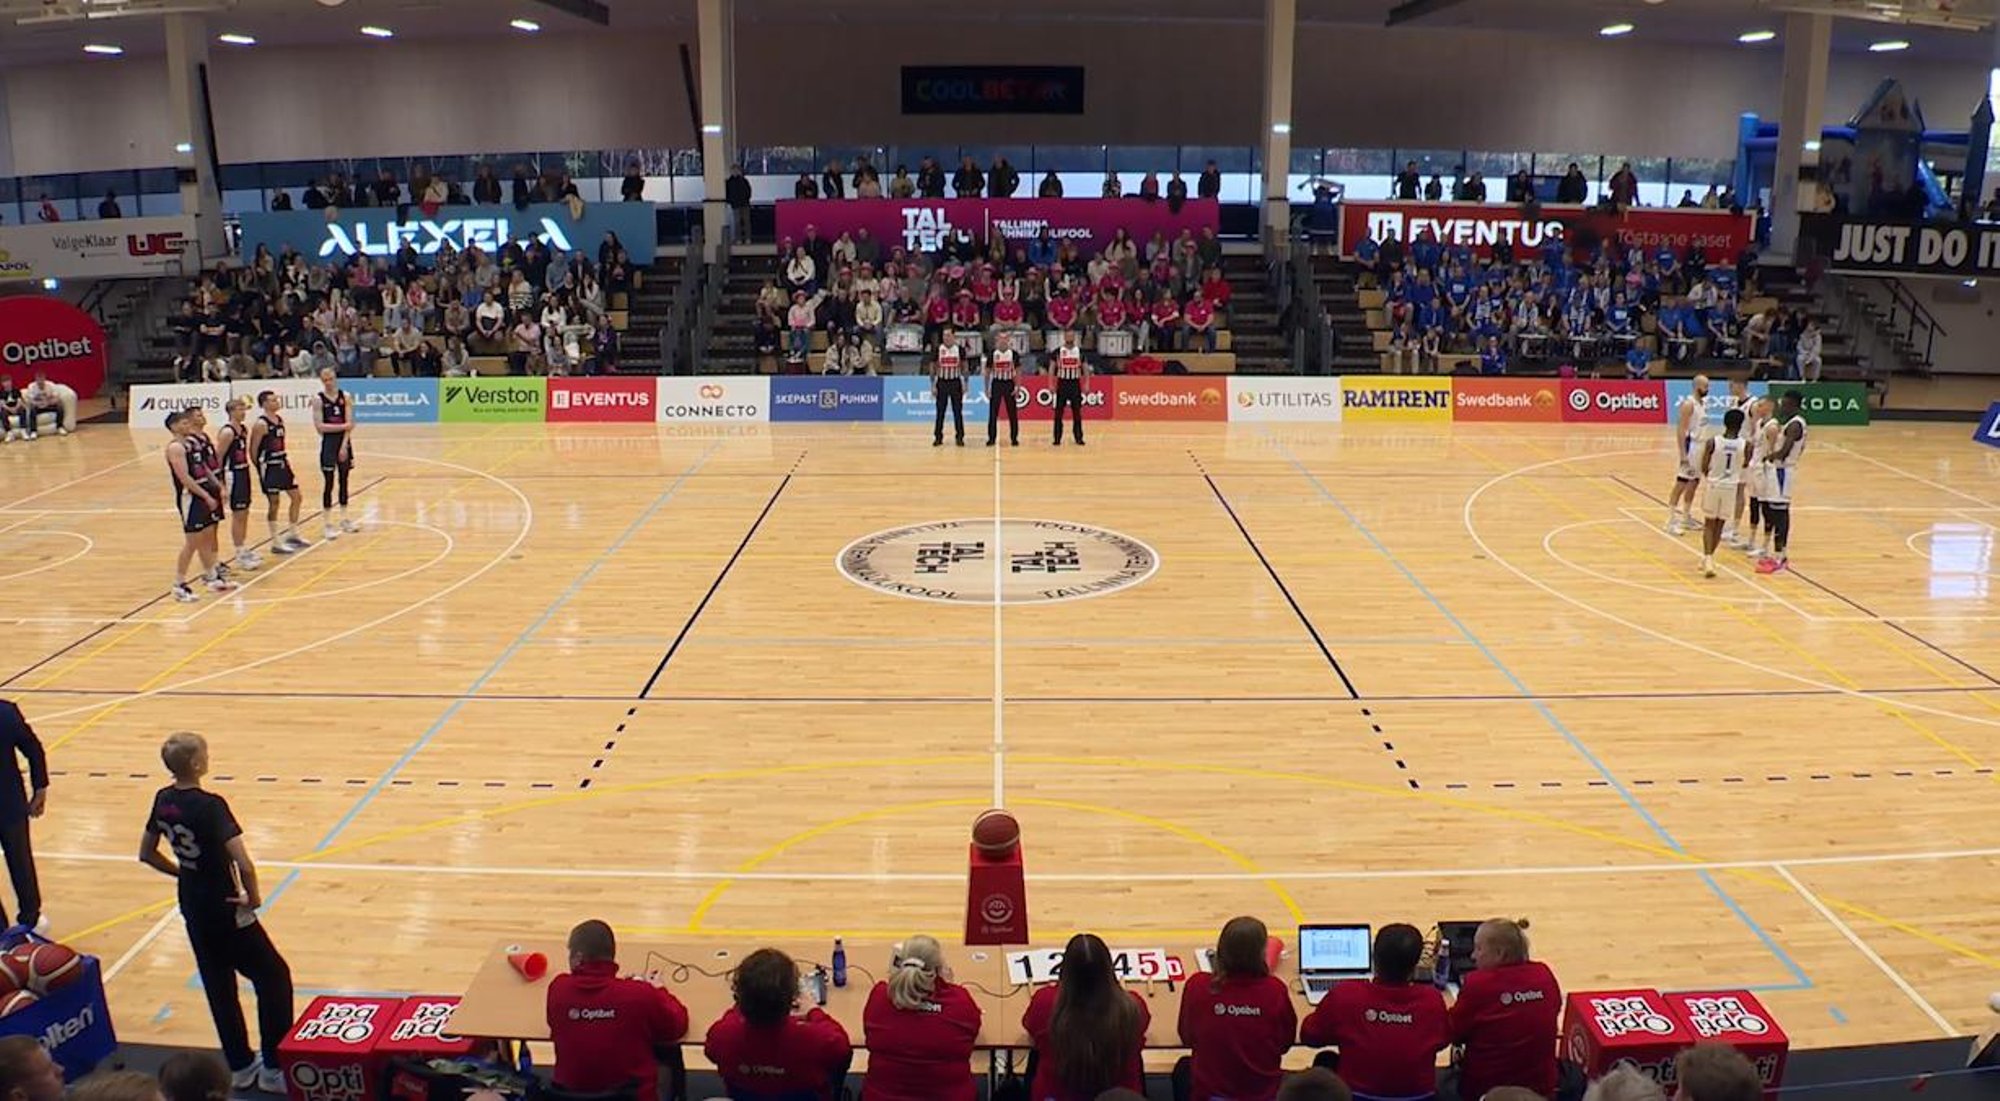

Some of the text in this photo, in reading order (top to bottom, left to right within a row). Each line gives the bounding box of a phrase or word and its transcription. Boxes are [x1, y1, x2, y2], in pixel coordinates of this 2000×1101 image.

[902, 207, 952, 230] TAL
[318, 217, 572, 257] ALEXELA
[902, 229, 970, 252] TEC
[1833, 224, 1911, 264] JUST
[1918, 228, 1968, 268] DO
[2, 336, 92, 365] Optibet
[350, 392, 430, 406] LEXELA
[465, 386, 539, 404] Verston
[572, 392, 650, 406] EVENTUS
[775, 394, 817, 405] SKEPAST
[892, 391, 988, 404] ALELA
[1037, 389, 1104, 409] Opbet
[1119, 391, 1197, 407] Swedbank
[1259, 392, 1331, 407] UTILITAS
[1344, 389, 1450, 408] RAMIRENT
[1457, 392, 1532, 407] Swedbank
[1596, 392, 1659, 413] Optibet
[1800, 397, 1860, 410] ODA
[665, 404, 757, 417] CONNECTO
[1726, 453, 1733, 470] 1
[1015, 955, 1034, 979] 1
[1048, 952, 1067, 976] 2
[1113, 952, 1132, 977] 4
[1138, 952, 1159, 979] 5
[320, 1004, 379, 1023] bet
[415, 1004, 456, 1021] et
[581, 1008, 616, 1020] Optibet
[1227, 1003, 1261, 1016] Optibet
[1379, 1010, 1413, 1024] Optibet
[1593, 999, 1653, 1018] bet
[1687, 999, 1747, 1018] bet
[39, 1007, 94, 1050] olten
[297, 1019, 373, 1042] Opti
[1597, 1015, 1673, 1037] Opti
[1691, 1015, 1767, 1037] Opti
[1755, 1054, 1779, 1080] ti
[292, 1062, 364, 1096] Opti
